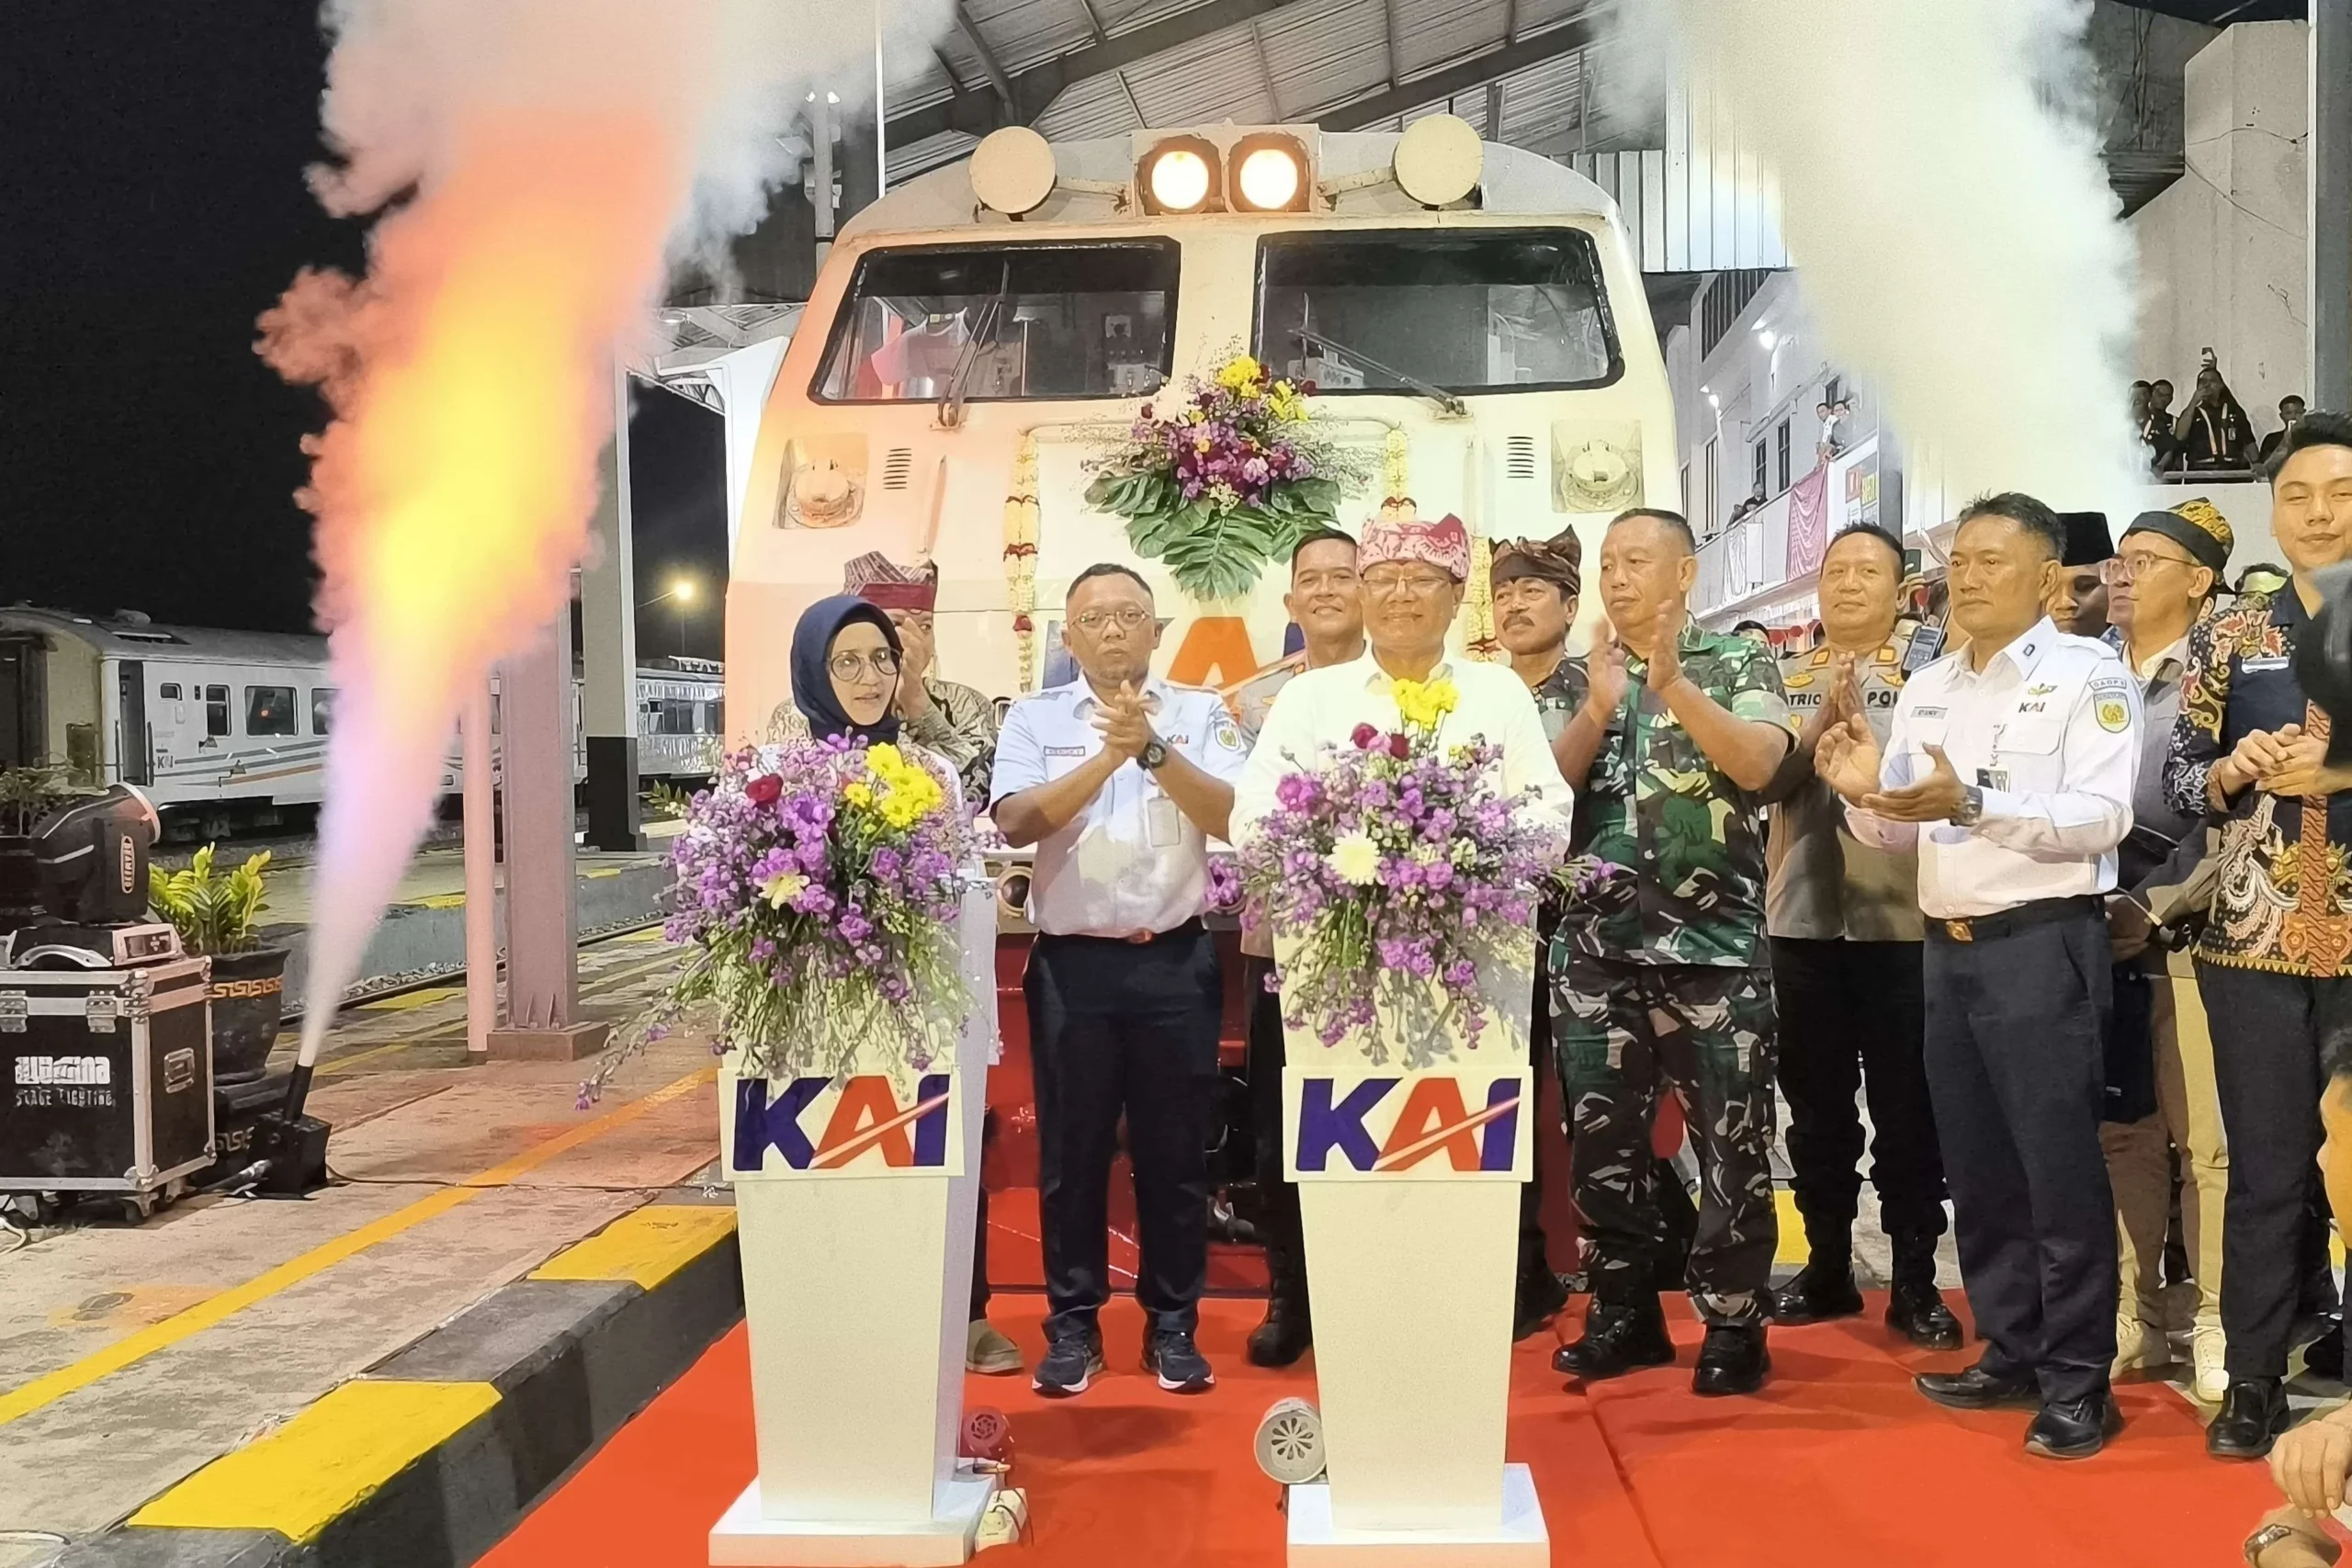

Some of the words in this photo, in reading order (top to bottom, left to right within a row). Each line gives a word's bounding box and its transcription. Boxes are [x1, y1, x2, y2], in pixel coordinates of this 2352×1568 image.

[2018, 702, 2046, 713] KAI
[734, 1075, 950, 1170] KAI
[1295, 1077, 1521, 1172] KAI
